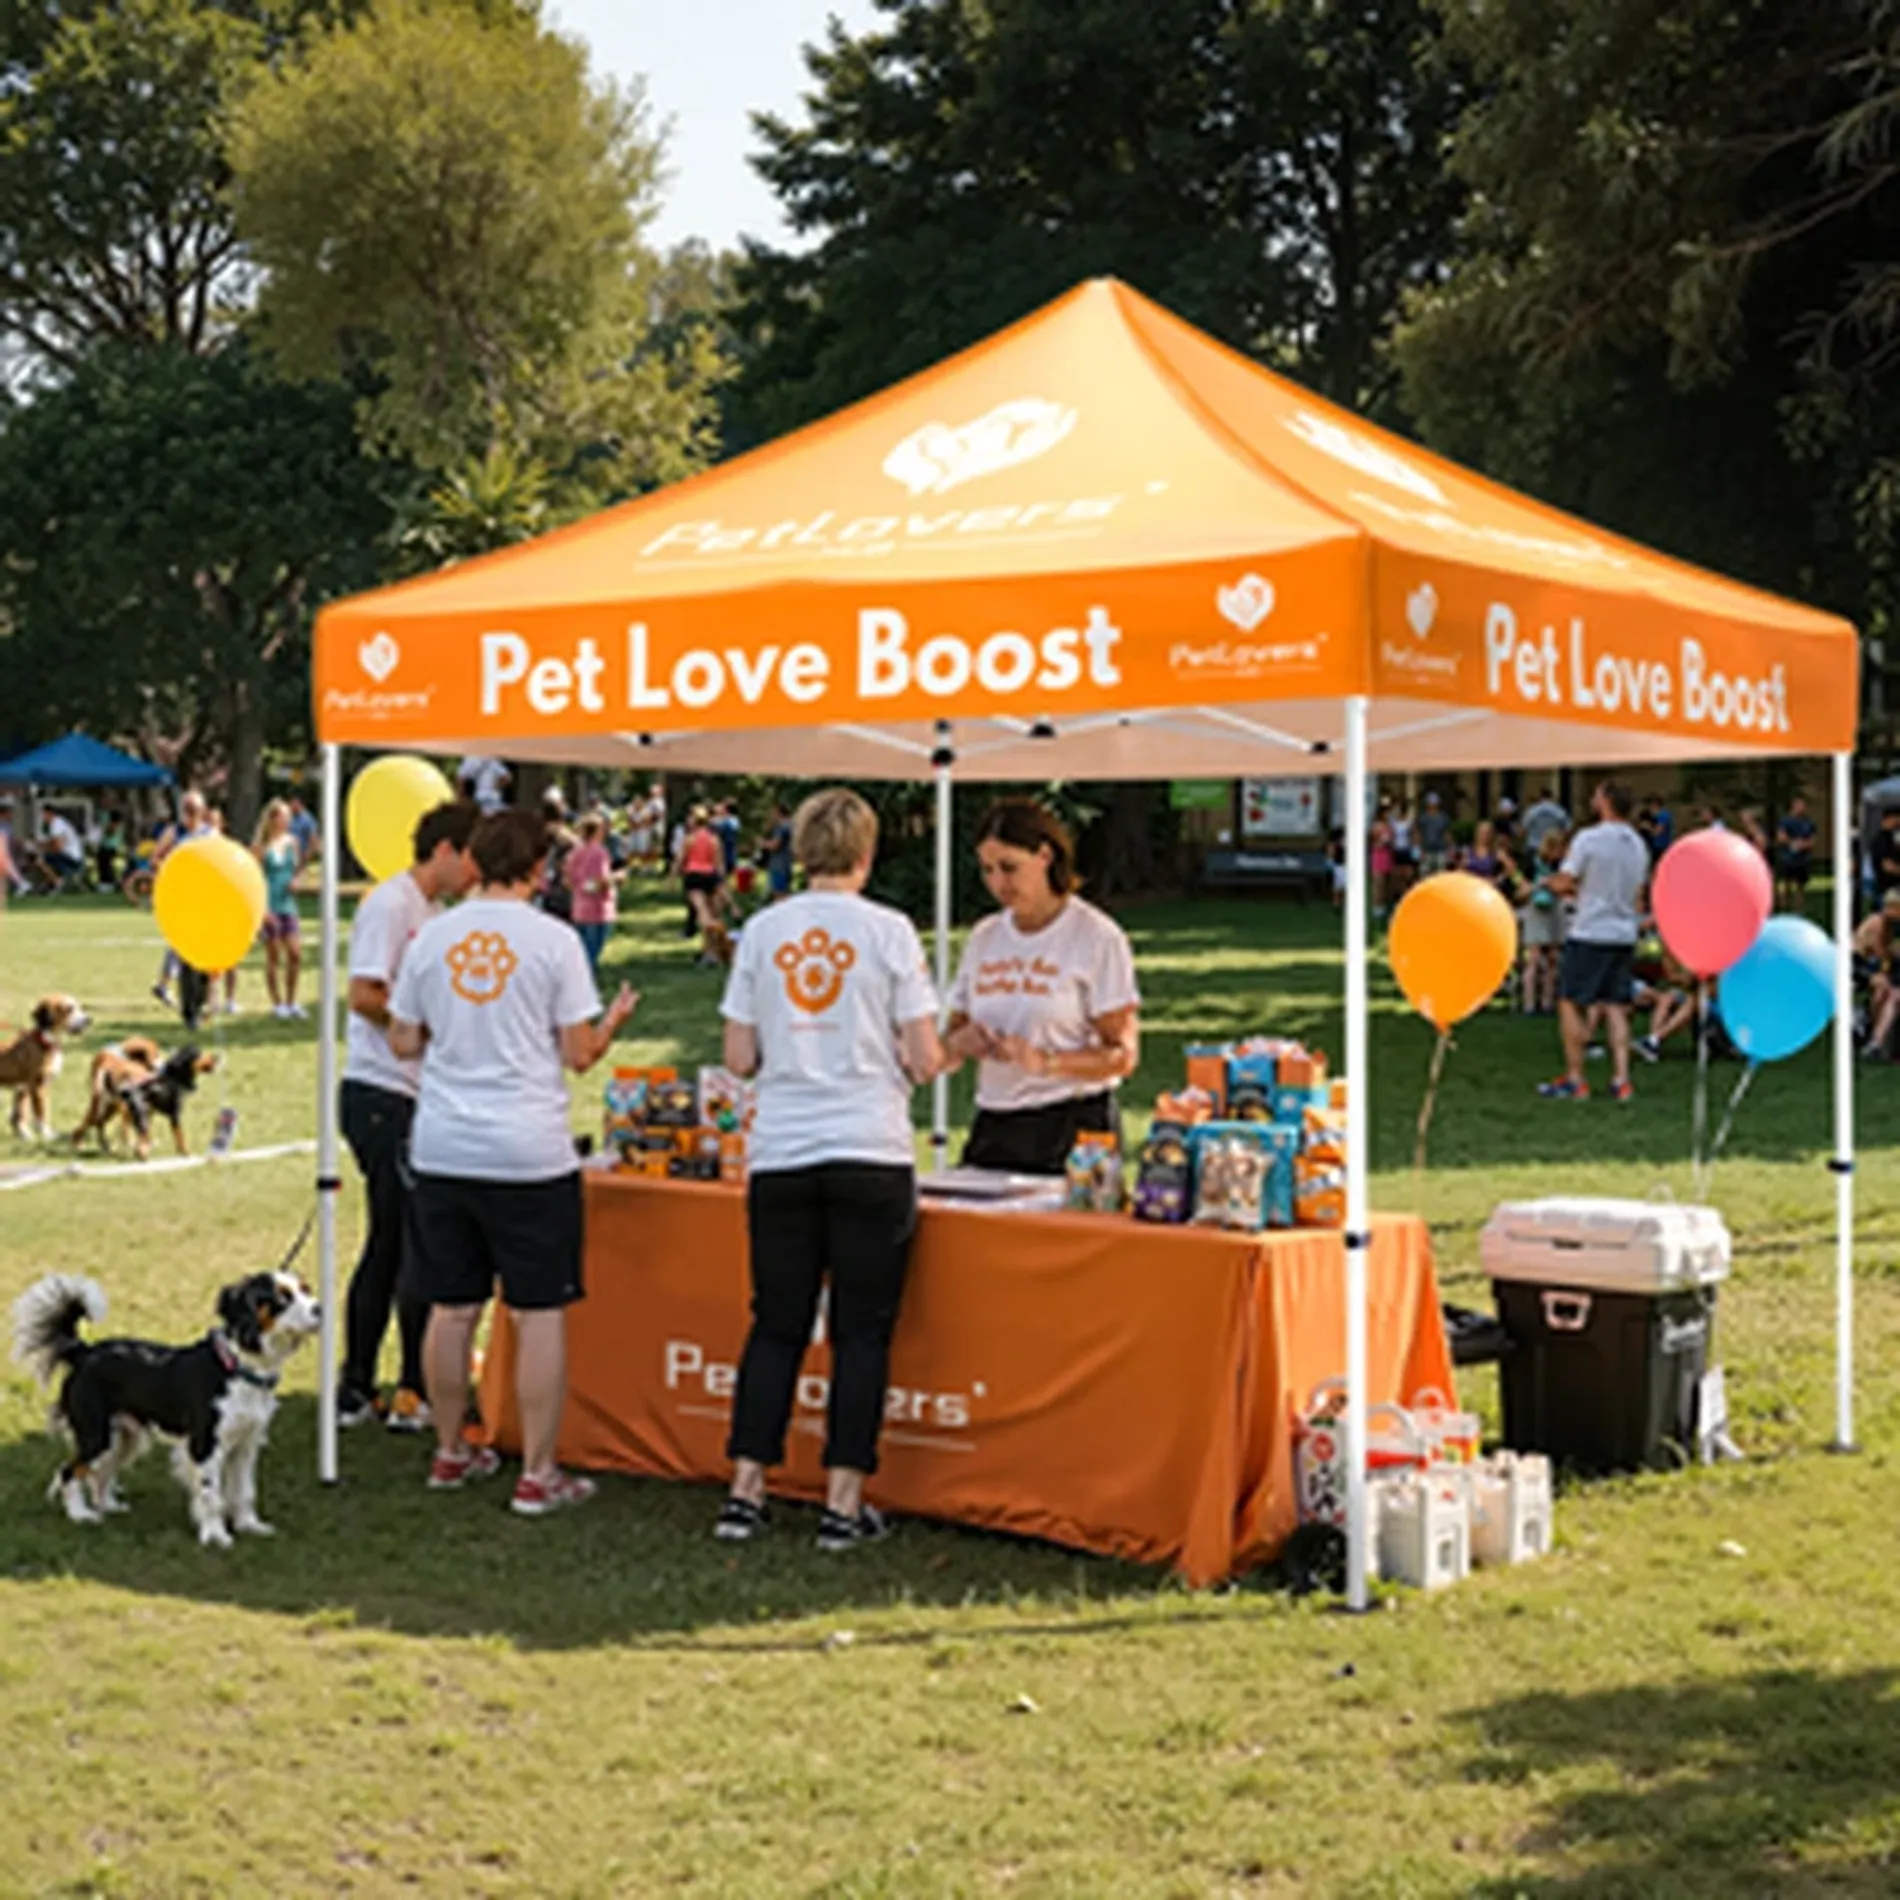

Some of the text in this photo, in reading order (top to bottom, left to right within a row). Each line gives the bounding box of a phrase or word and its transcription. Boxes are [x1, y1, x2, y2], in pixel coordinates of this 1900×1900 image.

[480, 606, 1123, 714] Pet Love Boost
[1485, 602, 1791, 732] Pet Love Boost
[665, 1340, 970, 1427] Peoers
